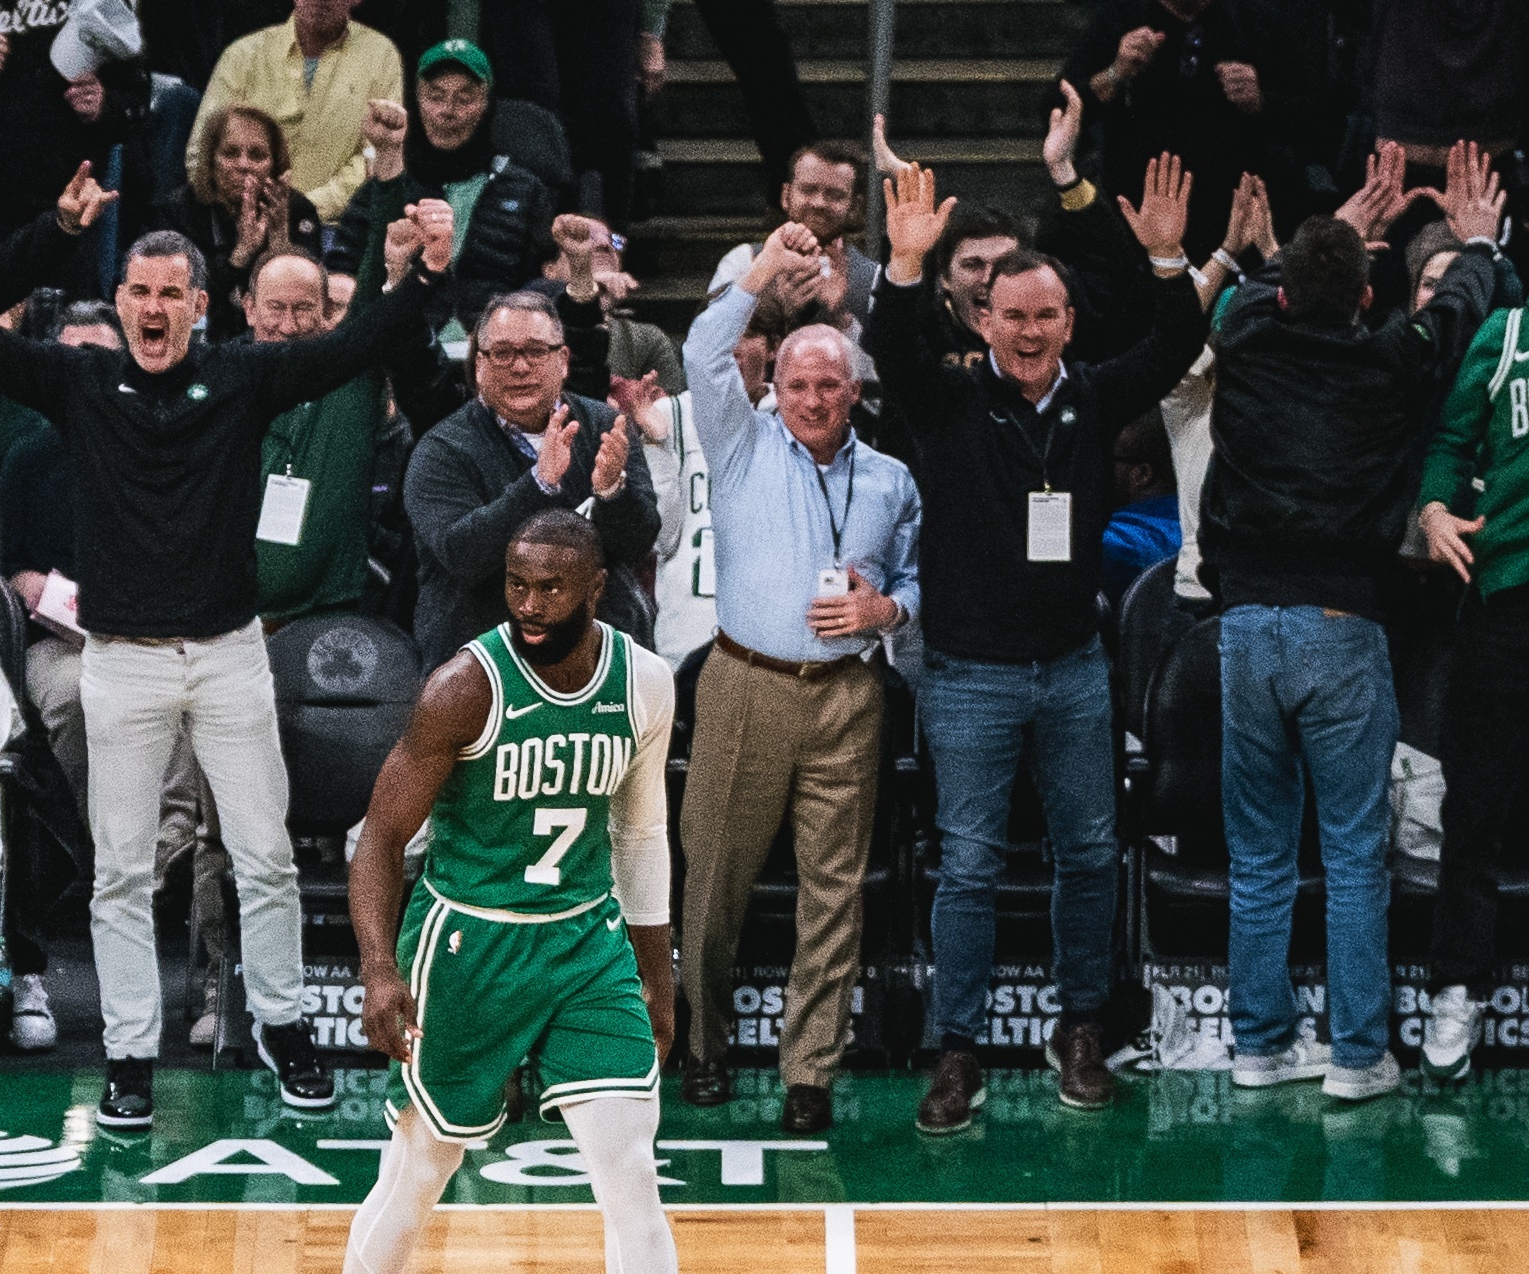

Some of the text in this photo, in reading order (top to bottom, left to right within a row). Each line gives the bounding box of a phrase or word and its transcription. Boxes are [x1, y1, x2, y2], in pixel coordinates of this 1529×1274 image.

[493, 732, 632, 801] BOSTON
[523, 807, 588, 886] 7
[301, 984, 366, 1015] STO
[985, 984, 1063, 1015] STO
